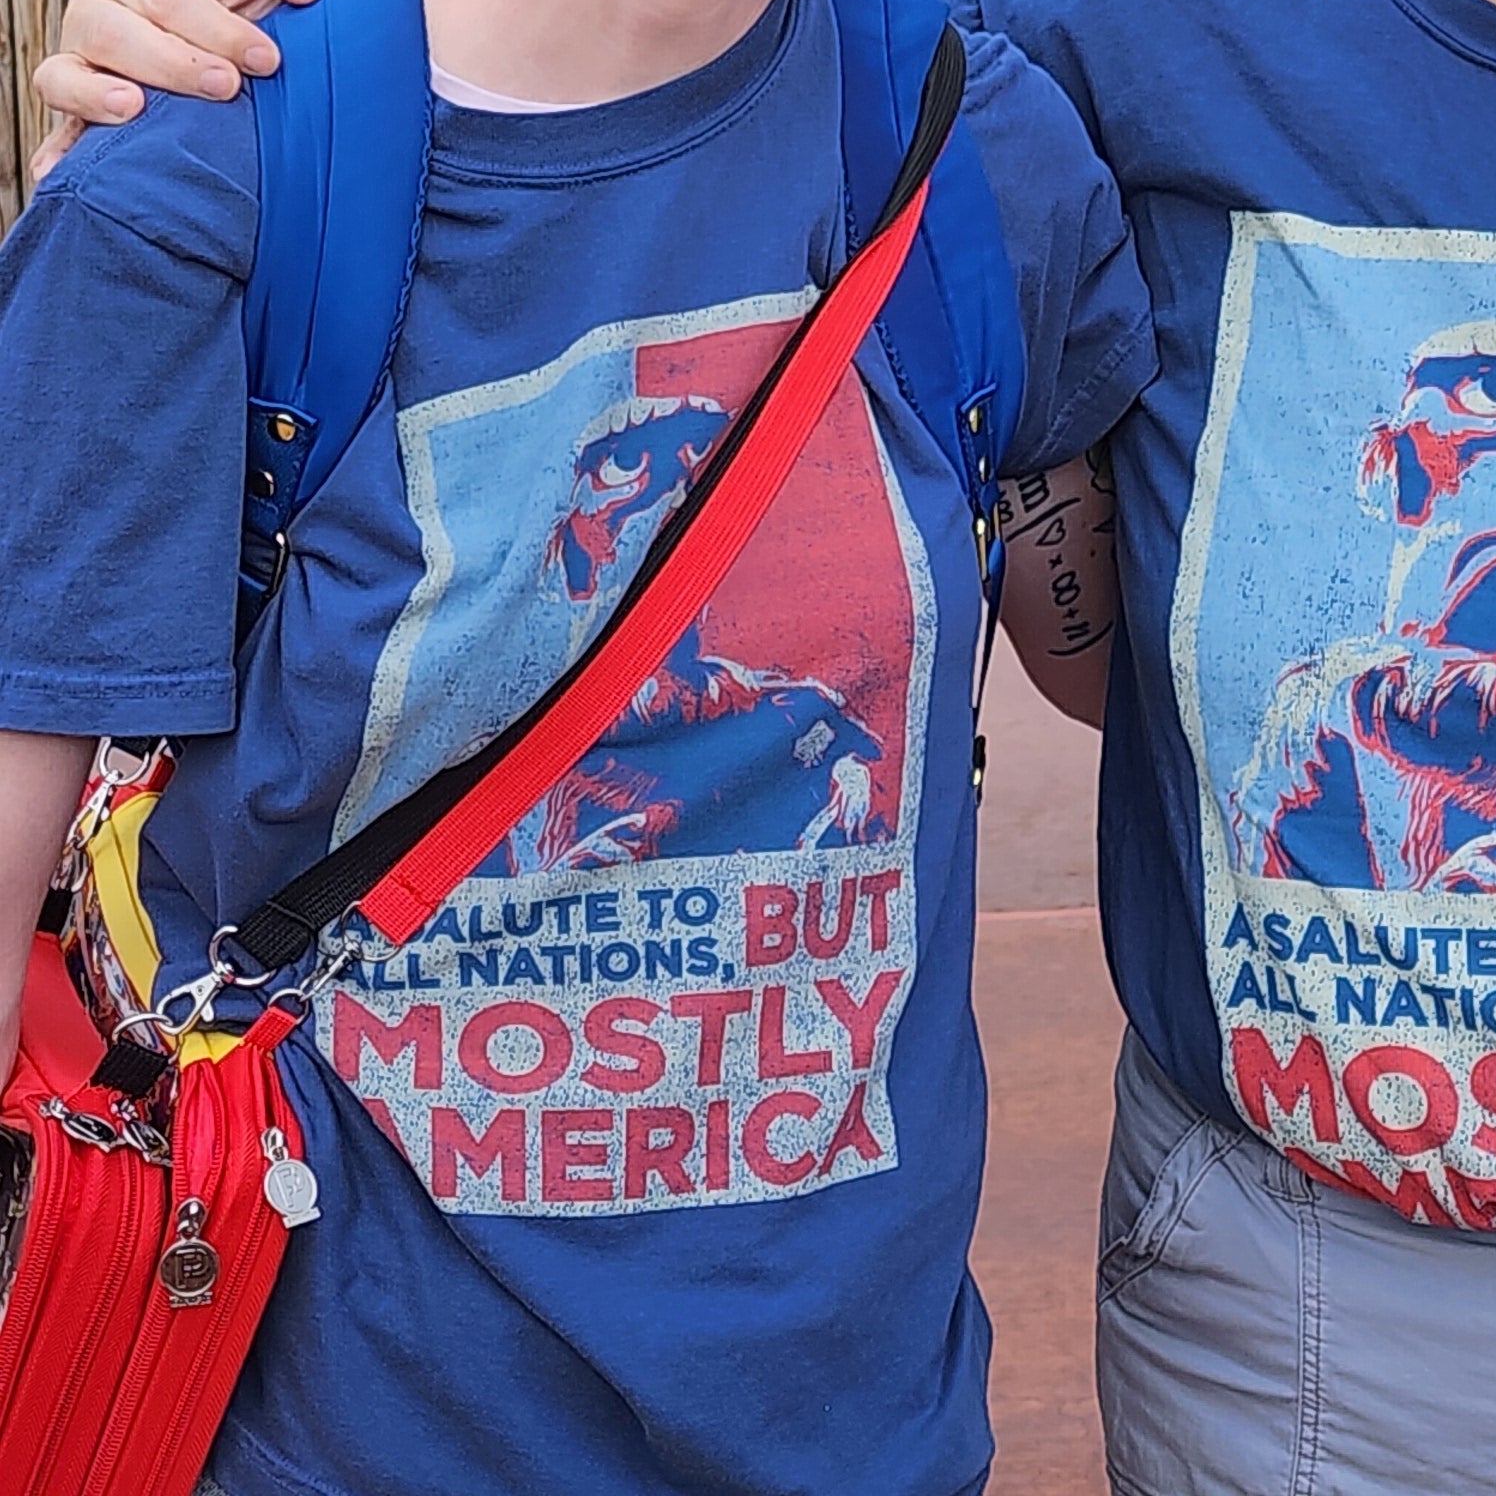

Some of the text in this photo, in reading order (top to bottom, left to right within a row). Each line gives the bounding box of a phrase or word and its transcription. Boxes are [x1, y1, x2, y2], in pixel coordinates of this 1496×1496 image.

[402, 890, 621, 944] ALUTE
[636, 886, 719, 930] TO
[458, 937, 737, 990] NATIONS,
[743, 869, 902, 968] BUT
[1222, 904, 1259, 951] A
[1225, 961, 1317, 1022] ALL
[331, 969, 906, 1095] MOSTLY
